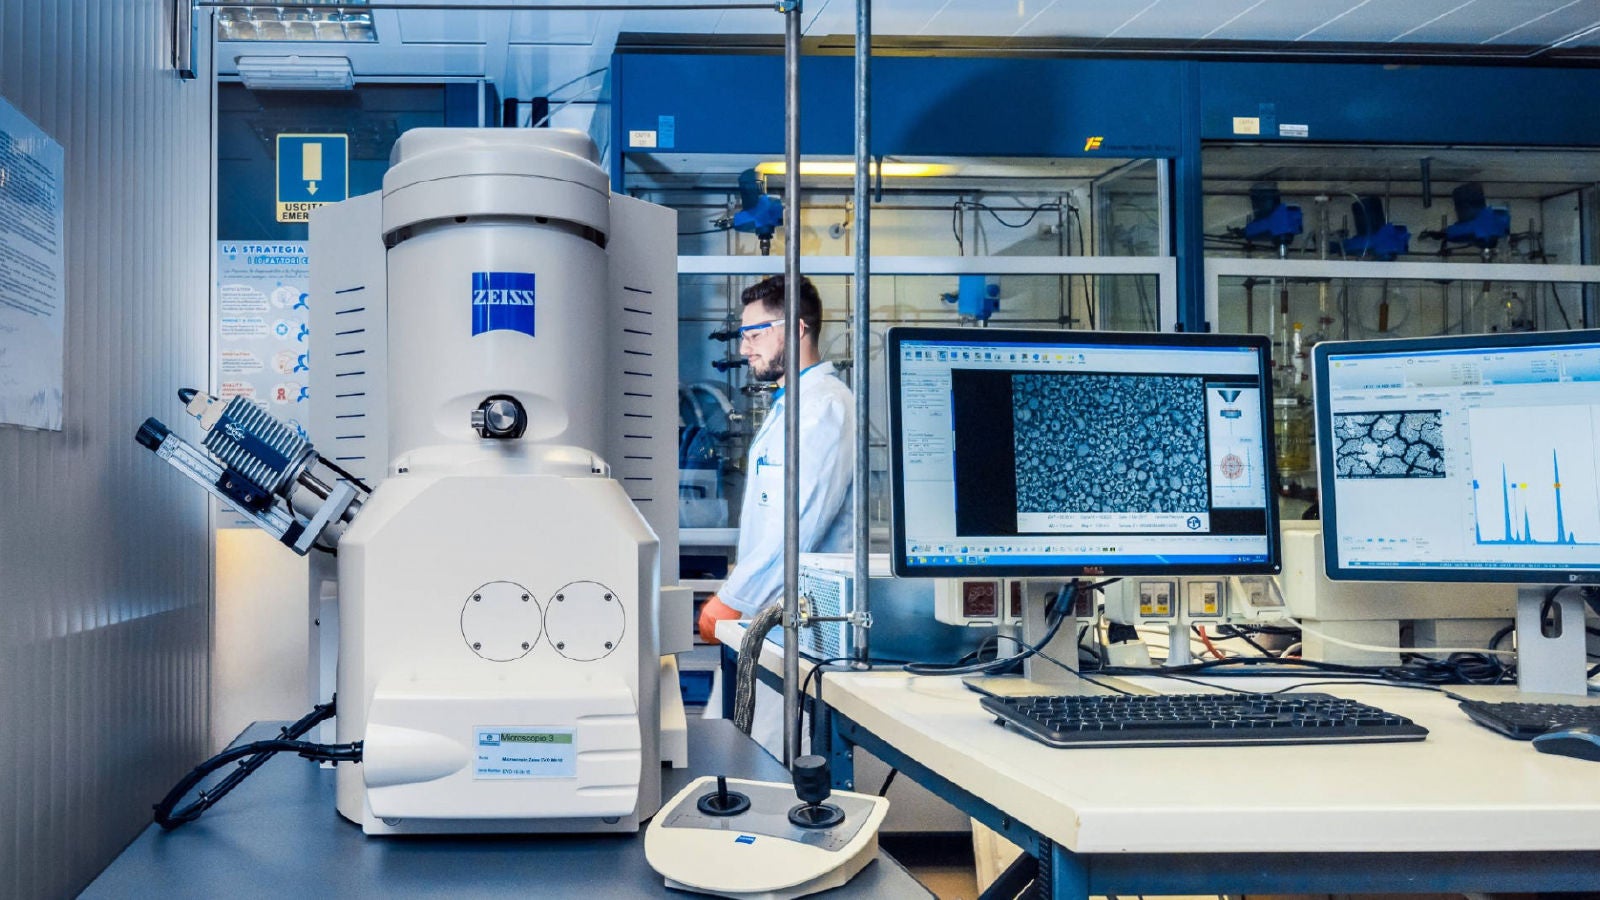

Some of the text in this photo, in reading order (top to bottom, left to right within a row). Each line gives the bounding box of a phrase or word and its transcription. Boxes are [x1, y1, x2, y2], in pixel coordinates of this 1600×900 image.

[282, 212, 309, 220] EMER
[223, 245, 305, 253] LA STRATEGIA
[265, 256, 299, 264] FATTORI
[473, 289, 534, 305] ZEISS
[500, 733, 547, 743] Microscopio
